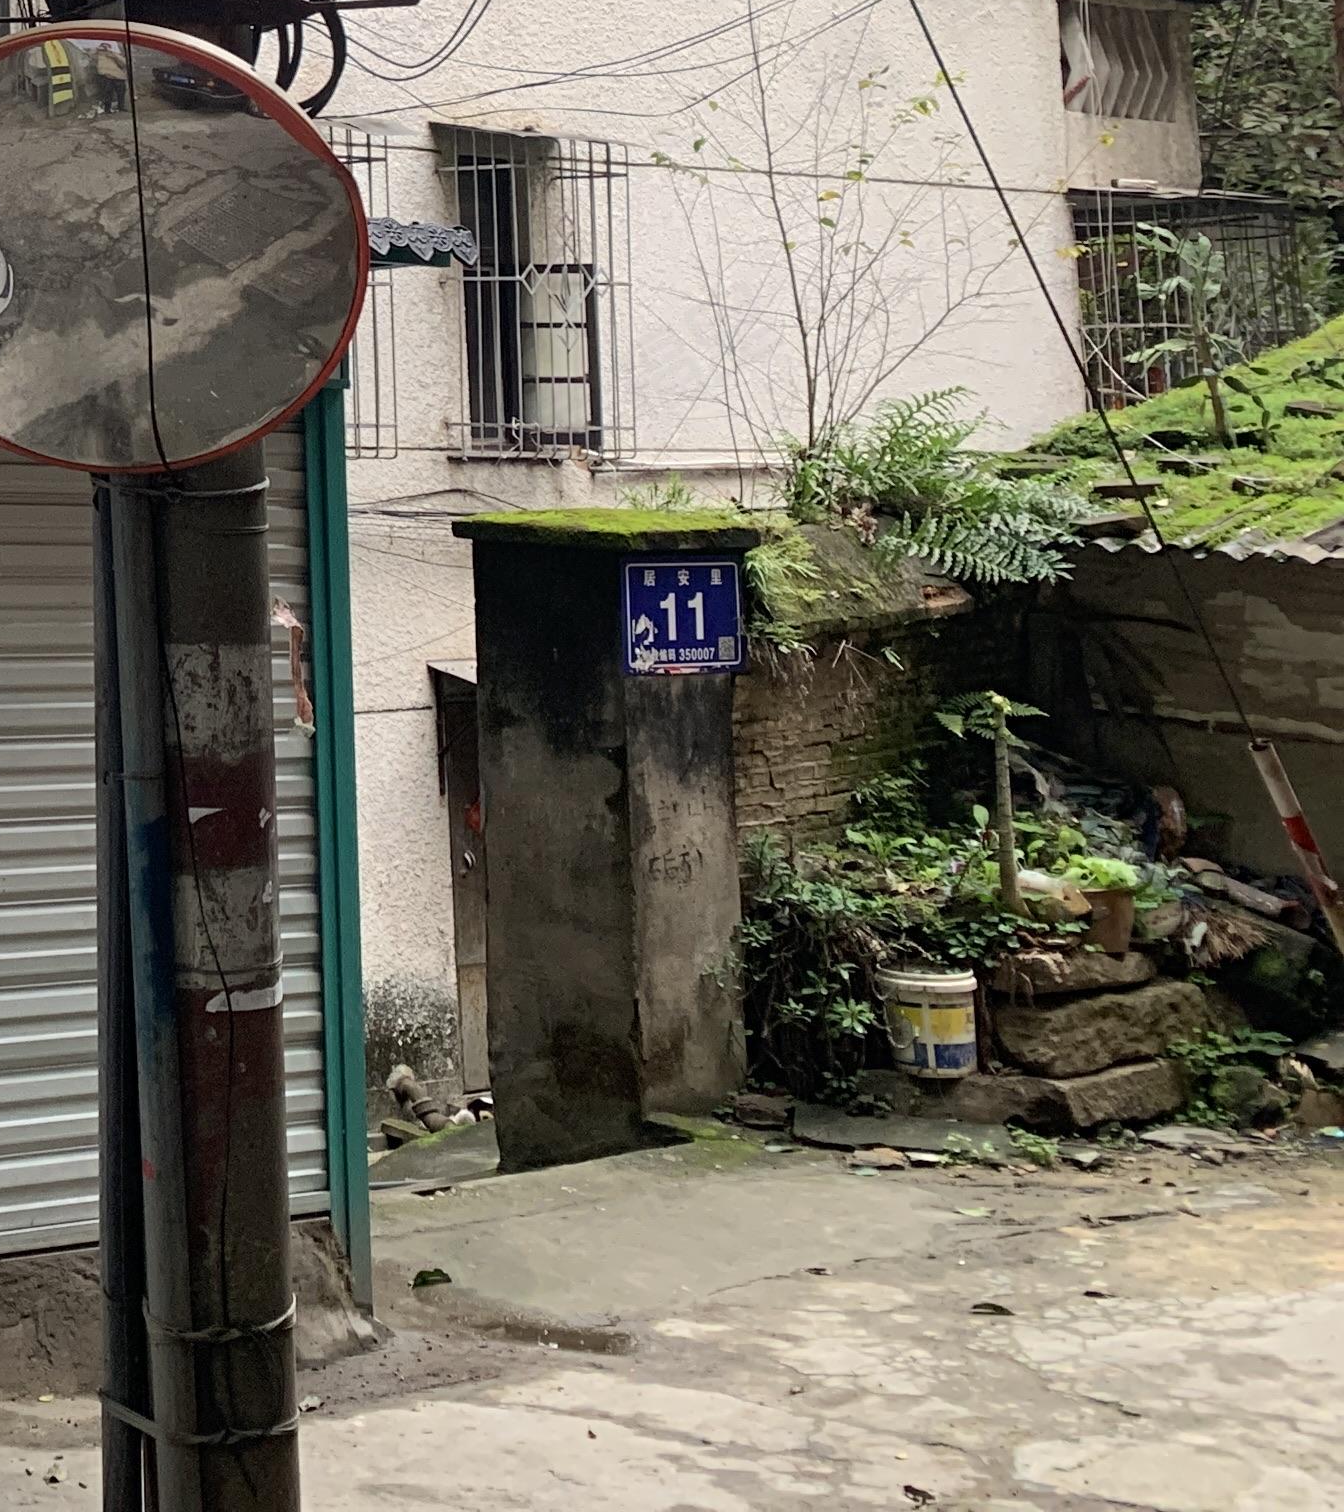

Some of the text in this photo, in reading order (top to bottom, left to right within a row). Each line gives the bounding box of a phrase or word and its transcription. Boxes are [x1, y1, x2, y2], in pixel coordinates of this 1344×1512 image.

[643, 568, 722, 587] 居安里
[659, 591, 705, 641] 11
[678, 647, 715, 661] 350007
